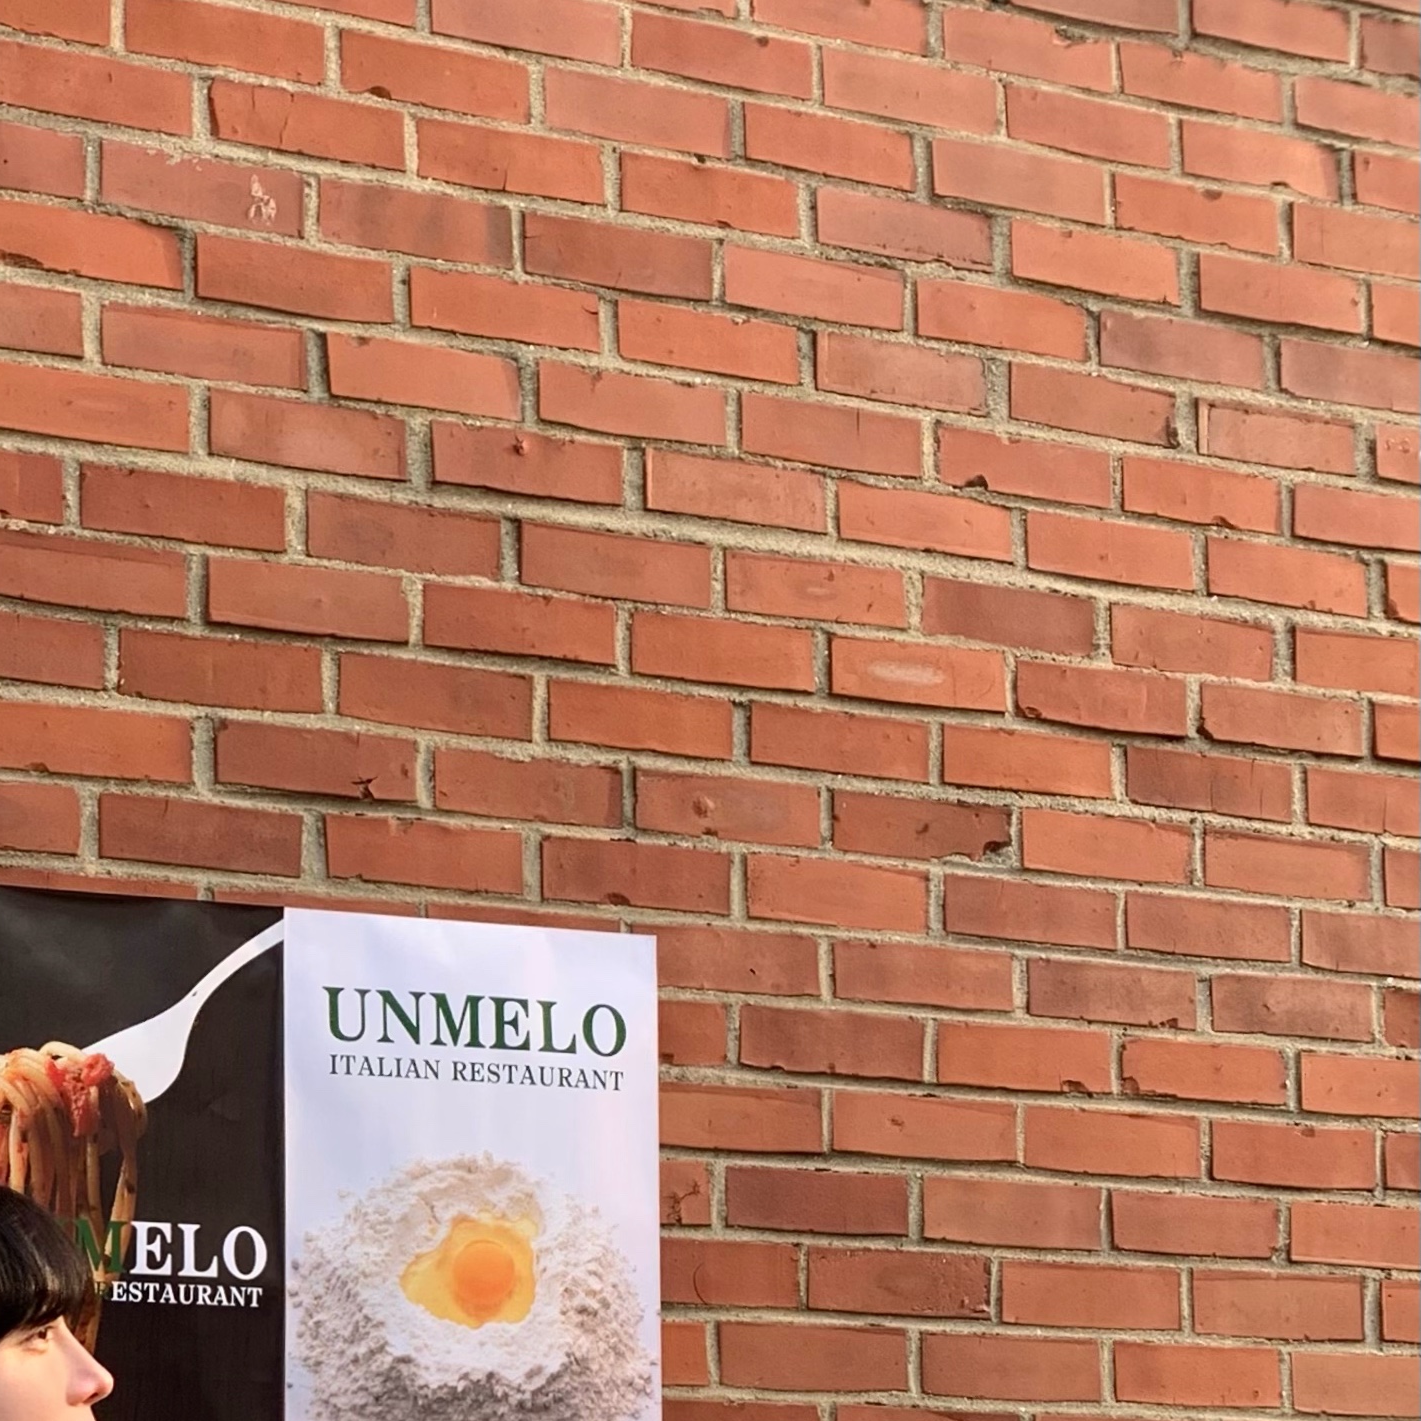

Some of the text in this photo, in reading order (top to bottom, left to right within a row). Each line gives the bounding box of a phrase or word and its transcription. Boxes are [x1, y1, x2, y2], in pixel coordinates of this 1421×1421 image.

[321, 986, 627, 1058] UNMELO
[329, 1054, 625, 1092] ITALIAN RESTAURANT
[73, 1218, 268, 1281] MELO
